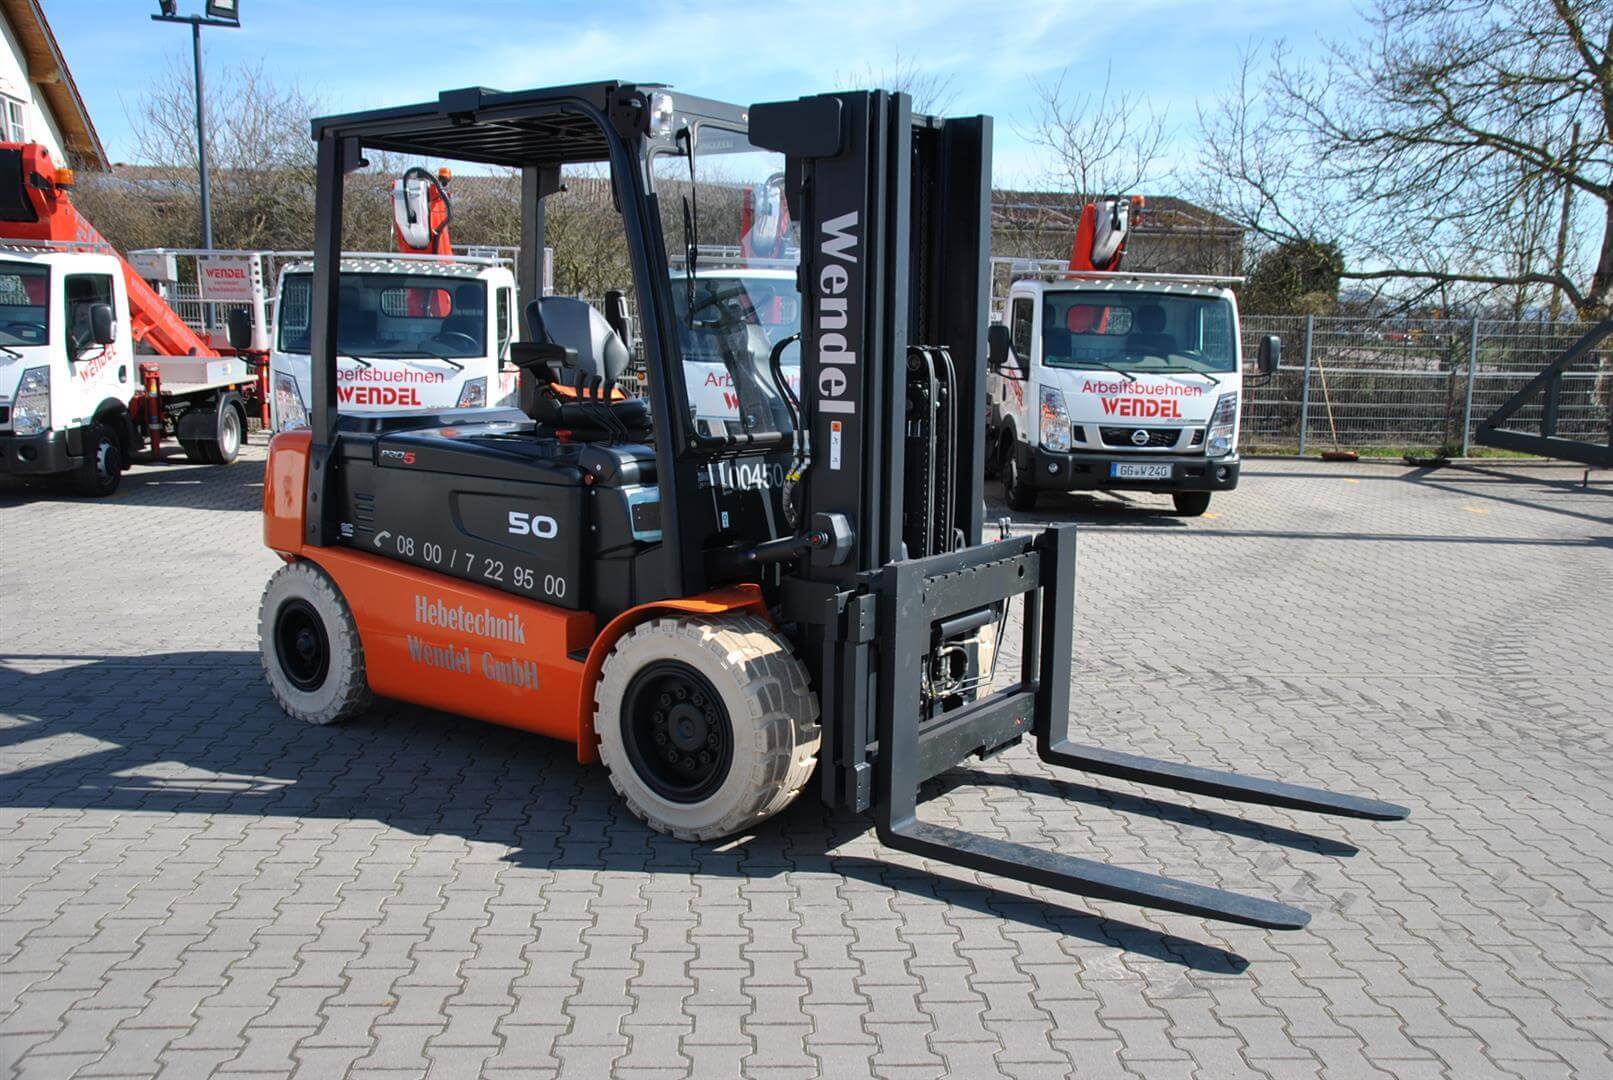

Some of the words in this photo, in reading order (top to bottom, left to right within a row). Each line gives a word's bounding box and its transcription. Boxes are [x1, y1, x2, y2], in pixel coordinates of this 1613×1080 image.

[205, 268, 246, 279] WENDEL
[818, 210, 859, 414] Wendel
[337, 367, 445, 384] beitsbuehnen
[337, 386, 422, 406] WENDEL
[1082, 379, 1202, 397] Arbeitsbuehnen
[1101, 397, 1182, 418] WENDEL
[508, 511, 559, 539] 50
[396, 535, 415, 557] 08
[423, 542, 442, 565] 00
[465, 553, 475, 573] 7
[484, 558, 504, 582] 22
[513, 567, 534, 590] 95
[544, 574, 566, 598] 00
[415, 594, 526, 645] Hebetechnik
[407, 634, 472, 675] Wendel
[481, 651, 540, 690] GmbH
